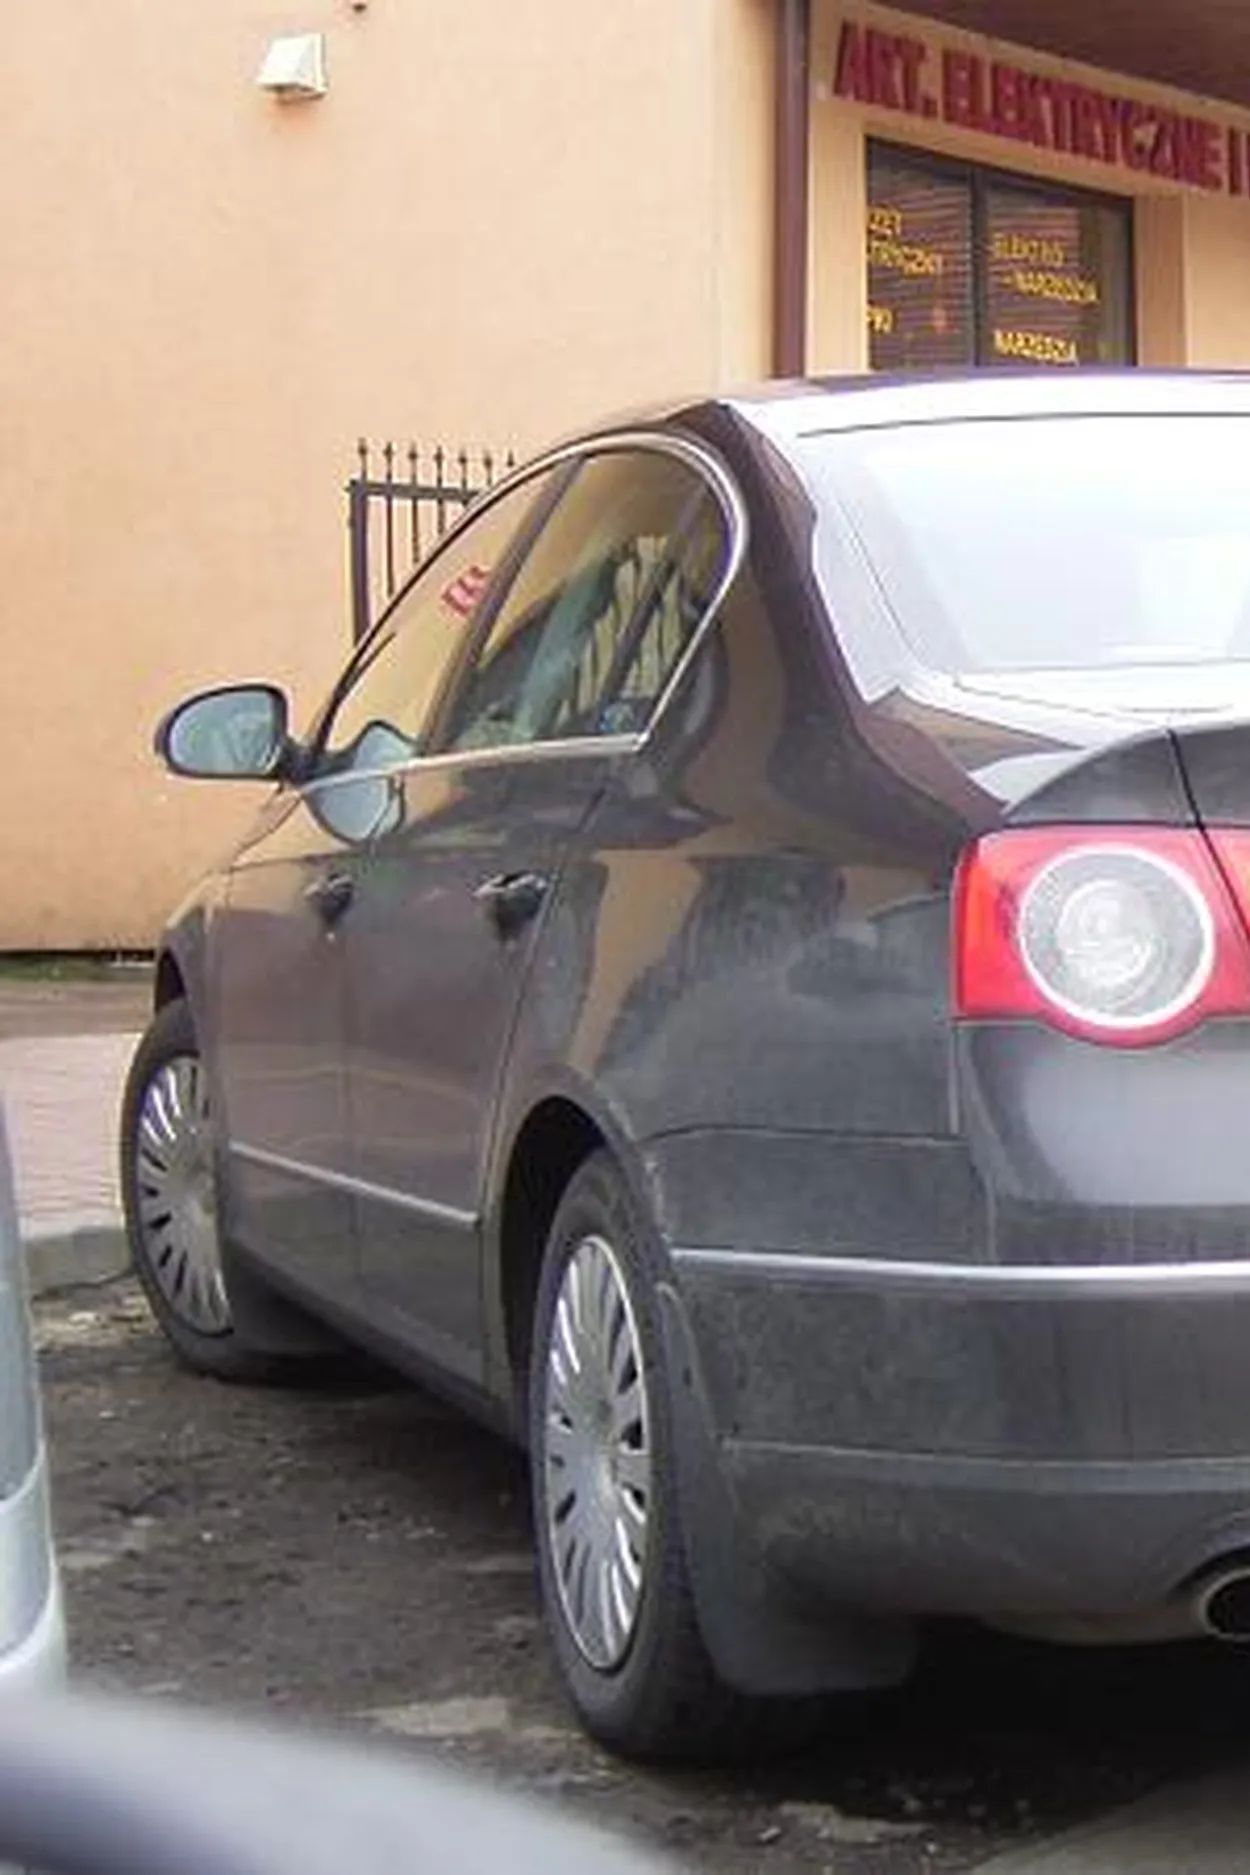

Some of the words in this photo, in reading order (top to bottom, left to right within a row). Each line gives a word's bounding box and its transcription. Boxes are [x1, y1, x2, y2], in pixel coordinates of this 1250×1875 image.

[833, 21, 938, 118] ART.
[941, 48, 1223, 192] ELEKTRYCZNE
[1229, 125, 1242, 196] I
